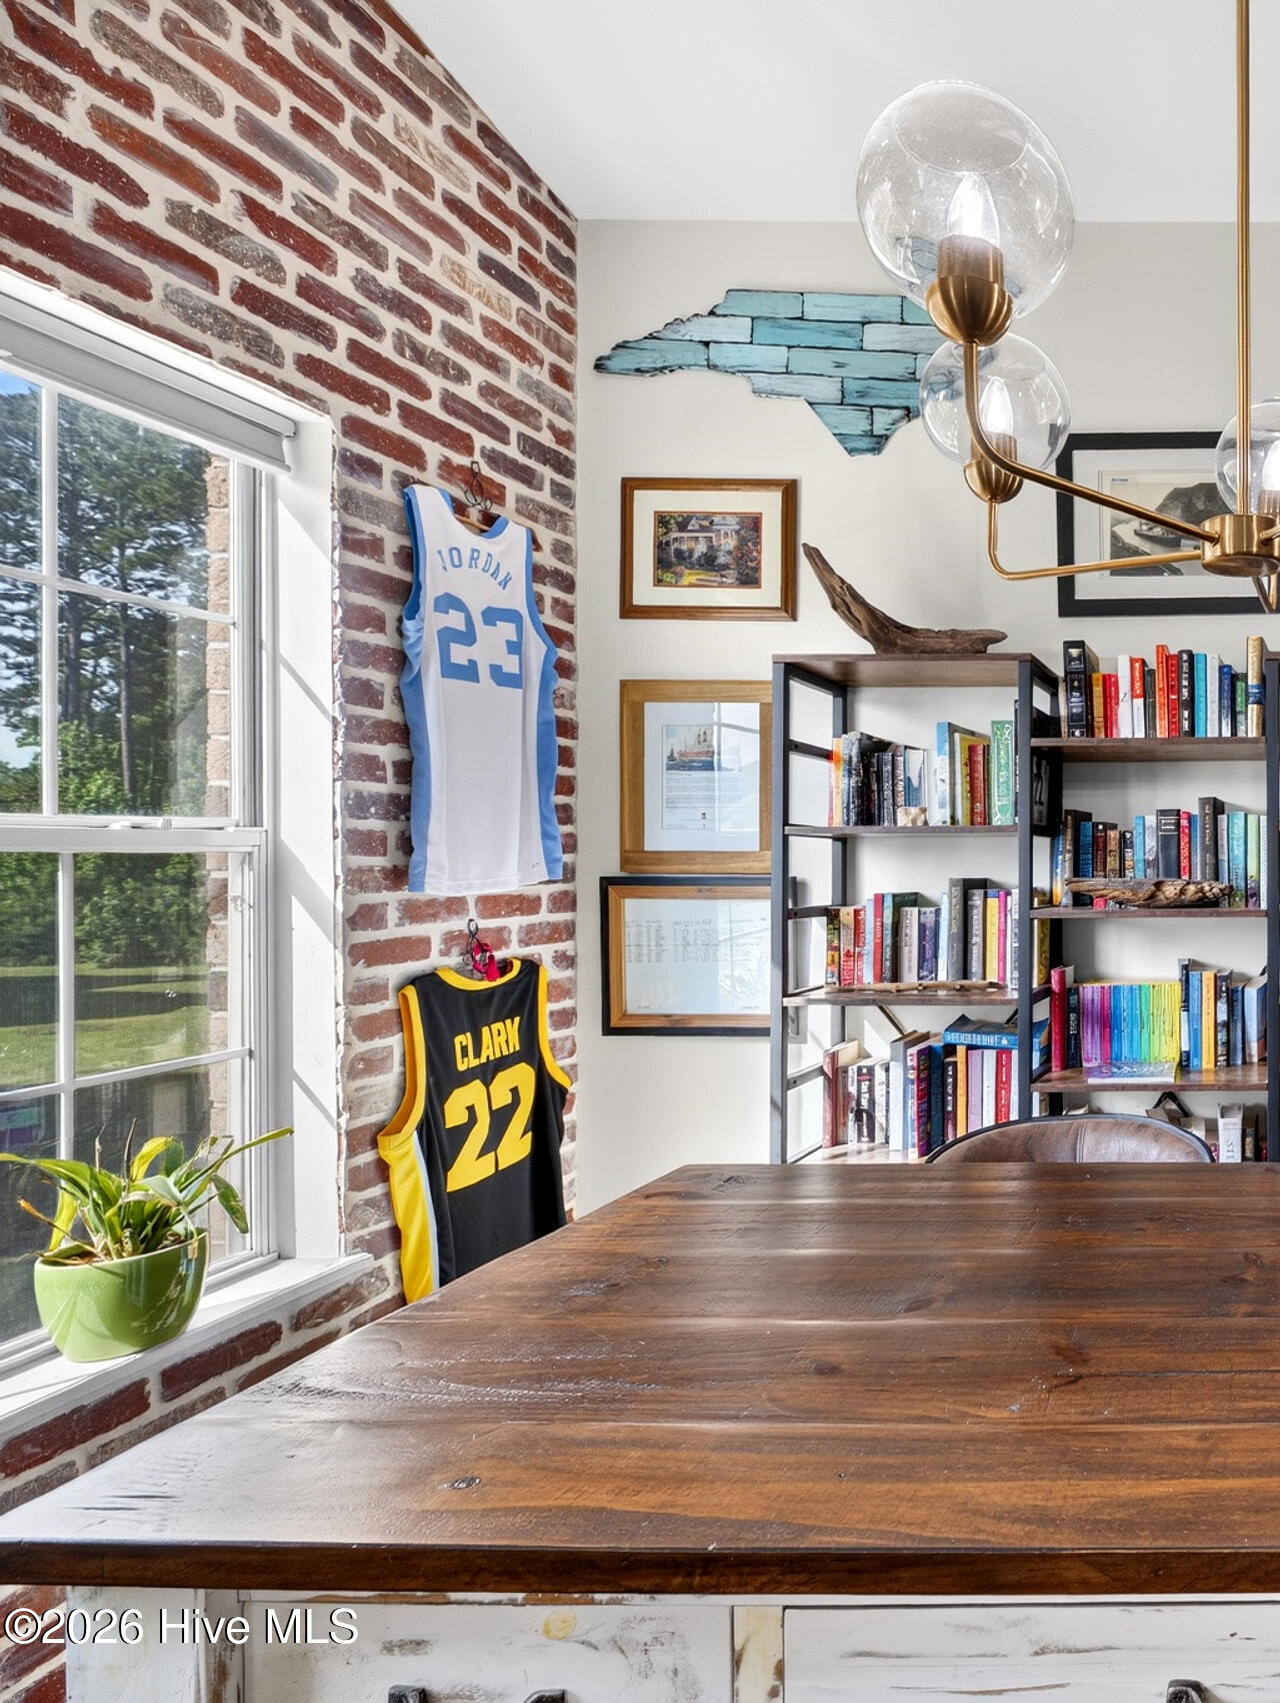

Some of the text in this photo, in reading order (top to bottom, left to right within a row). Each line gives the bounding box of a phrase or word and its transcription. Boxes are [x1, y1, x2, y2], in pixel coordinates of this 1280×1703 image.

[437, 547, 513, 591] JORDAN
[433, 592, 523, 689] 23
[453, 1016, 521, 1072] CLARK
[443, 1061, 536, 1193] 22
